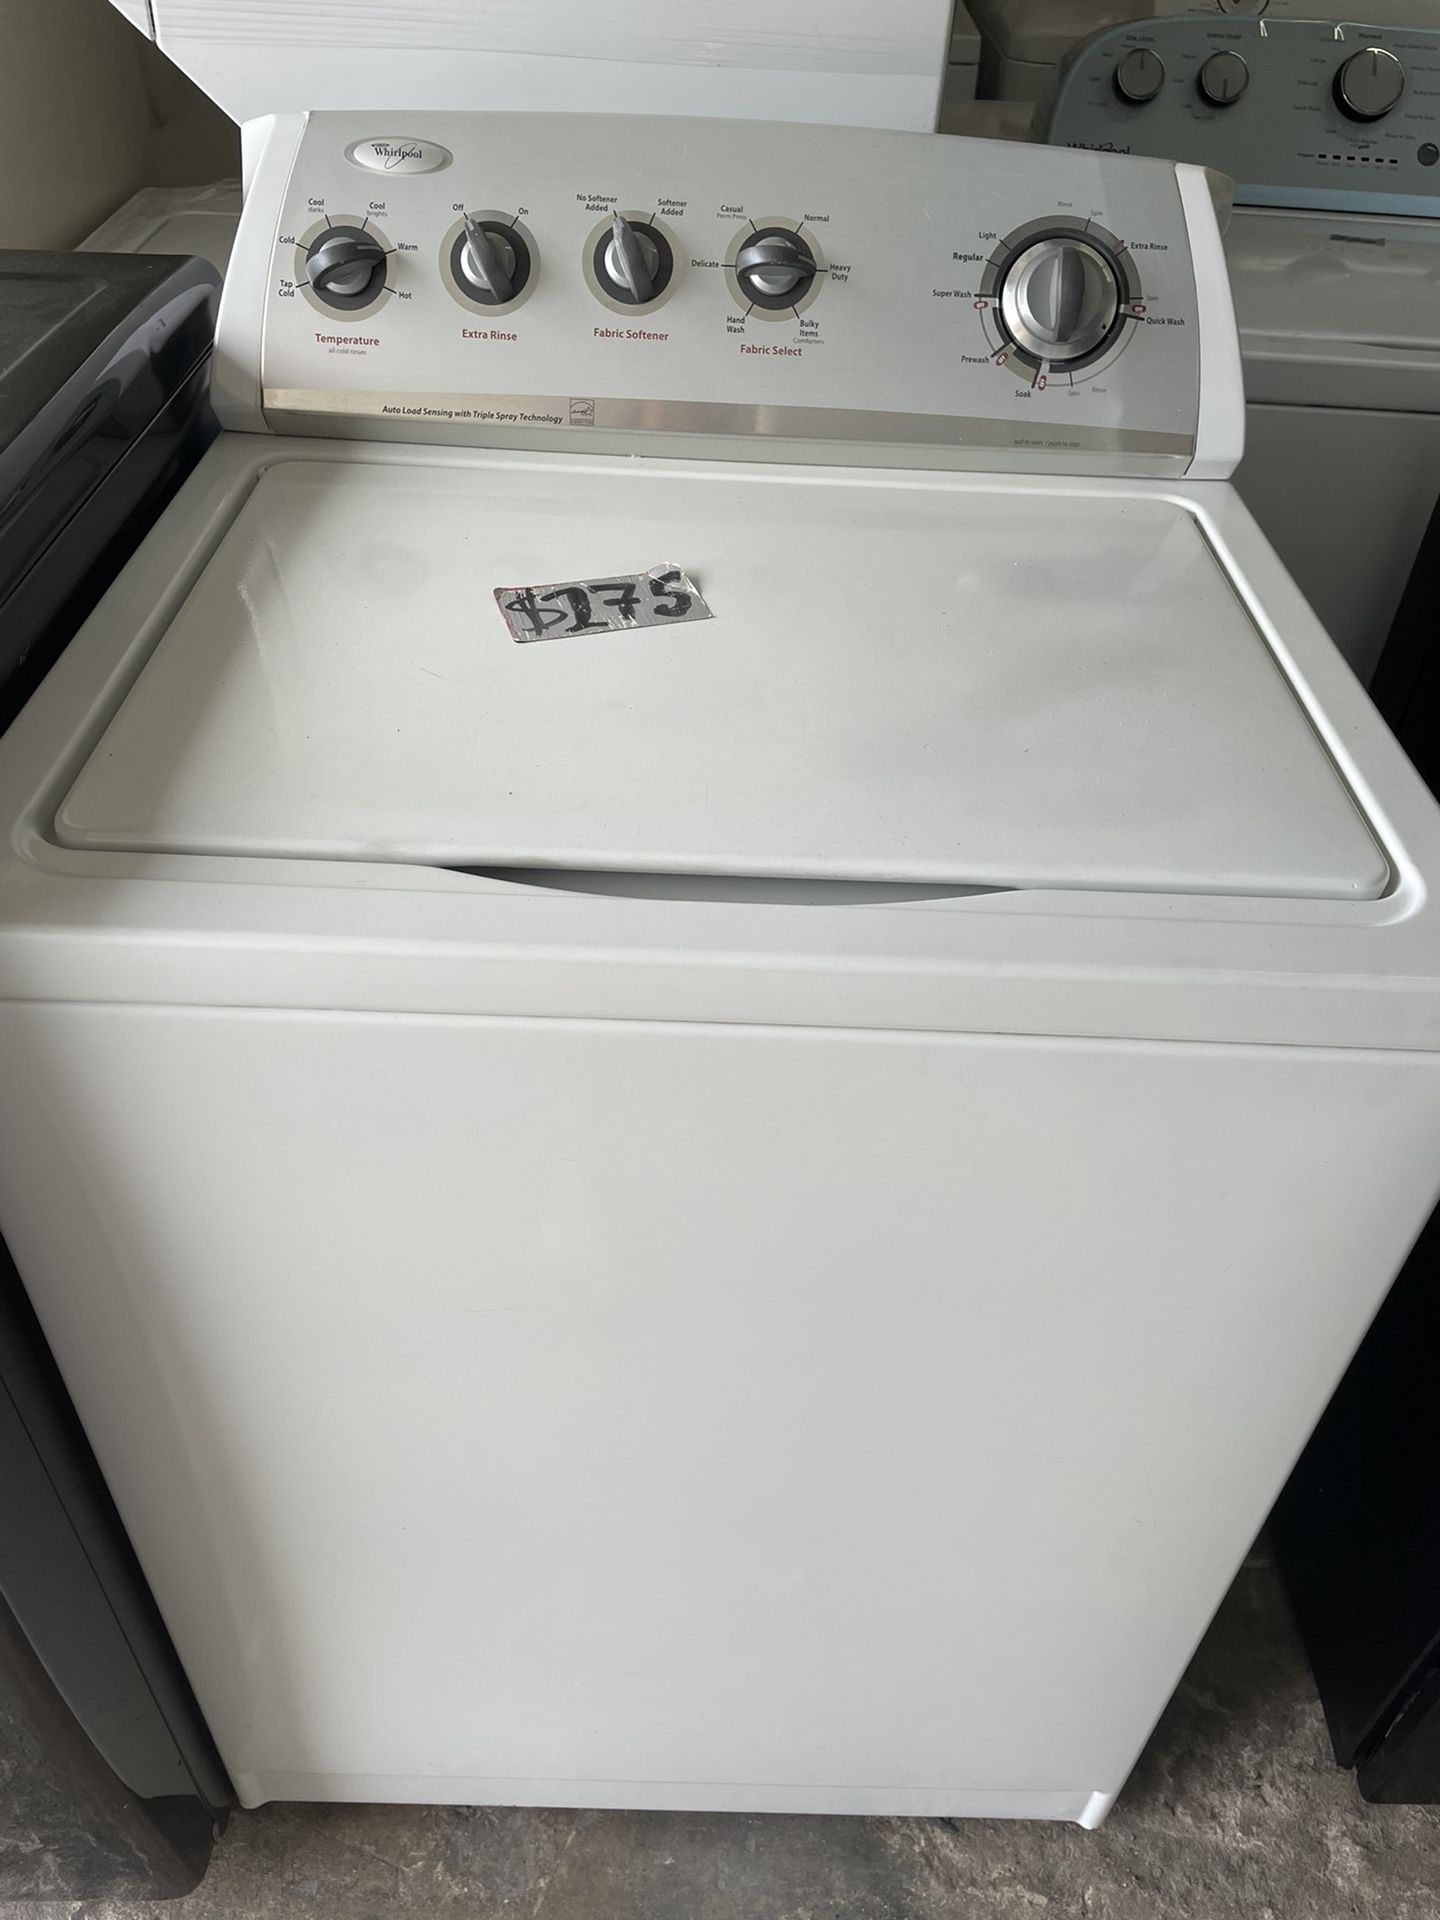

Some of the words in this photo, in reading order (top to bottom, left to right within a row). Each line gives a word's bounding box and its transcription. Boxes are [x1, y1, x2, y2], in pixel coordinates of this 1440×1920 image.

[374, 147, 423, 160] Whirlpool
[308, 198, 325, 206] Cool
[576, 193, 587, 202] No
[588, 194, 618, 203] Softener
[369, 202, 386, 210] Cool
[657, 198, 688, 207] Softener
[452, 203, 465, 211] Off
[518, 207, 529, 215] On
[585, 203, 609, 212] Added
[720, 205, 744, 213] Casual
[660, 208, 684, 216] Added
[804, 214, 830, 222] Normal
[279, 236, 296, 244] Cold
[978, 232, 997, 240] Light
[397, 243, 419, 251] Warm
[1130, 241, 1149, 250] Extra
[1149, 243, 1169, 251] Rinse
[953, 252, 984, 263] Regular
[691, 259, 720, 268] Delicate
[829, 264, 851, 273] Heavy
[831, 273, 849, 281] Duty
[280, 280, 294, 288] Tap
[278, 289, 295, 297] Cold
[398, 291, 412, 299] Hot
[932, 289, 953, 298] Super
[953, 290, 972, 298] Wash
[726, 316, 746, 324] Hand
[1146, 316, 1166, 325] Quick
[1167, 318, 1185, 326] Wash
[799, 320, 819, 329] Bulky
[726, 325, 745, 333] Wash
[799, 329, 819, 337] Items
[462, 329, 488, 340] Extra
[490, 330, 518, 341] Rinse
[593, 327, 624, 339] Fabric
[626, 329, 669, 341] Softener
[315, 333, 380, 346] Temperature
[740, 344, 770, 355] Fabric
[772, 346, 802, 357] Select
[961, 355, 990, 364] Prewash
[1014, 390, 1032, 398] Soak
[382, 405, 401, 414] Auto
[402, 407, 422, 415] Load
[422, 408, 453, 418] Sensing
[454, 410, 472, 418] with
[473, 410, 495, 420] Triple
[496, 412, 518, 421] Spray
[519, 413, 563, 424] Technology
[504, 570, 693, 636] $175
